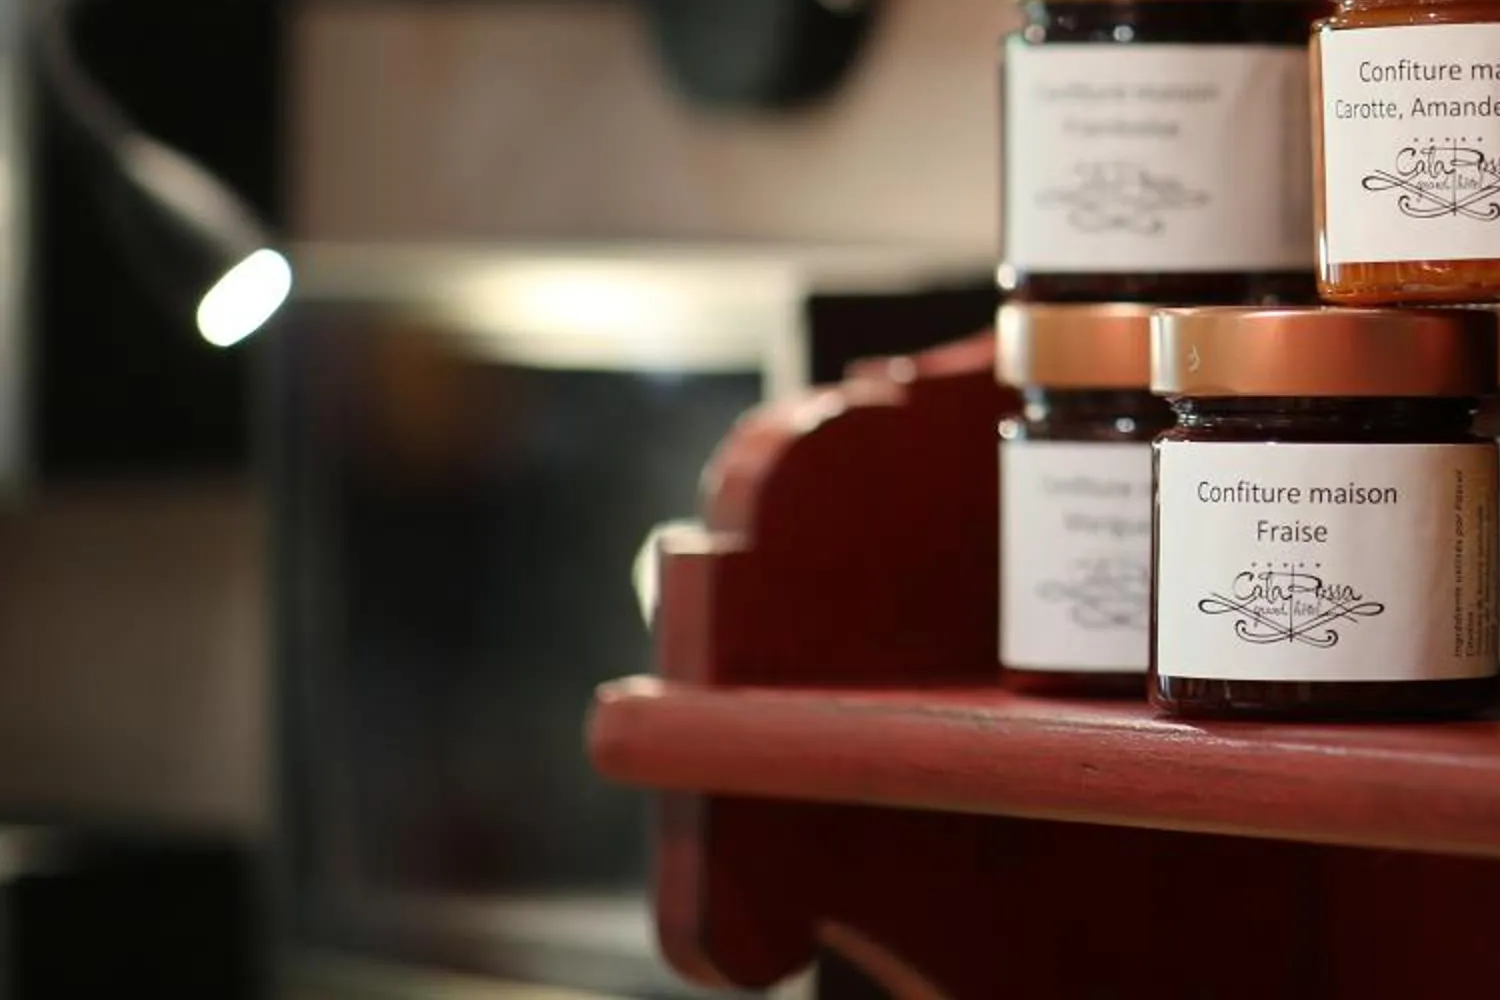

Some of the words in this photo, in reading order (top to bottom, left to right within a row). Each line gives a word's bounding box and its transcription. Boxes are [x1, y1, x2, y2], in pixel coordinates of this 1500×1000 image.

[1359, 59, 1463, 84] Confiture
[1334, 98, 1403, 120] Carotte,
[1197, 481, 1301, 505] Confiture
[1309, 481, 1398, 505] maison
[1256, 520, 1329, 544] Fraise
